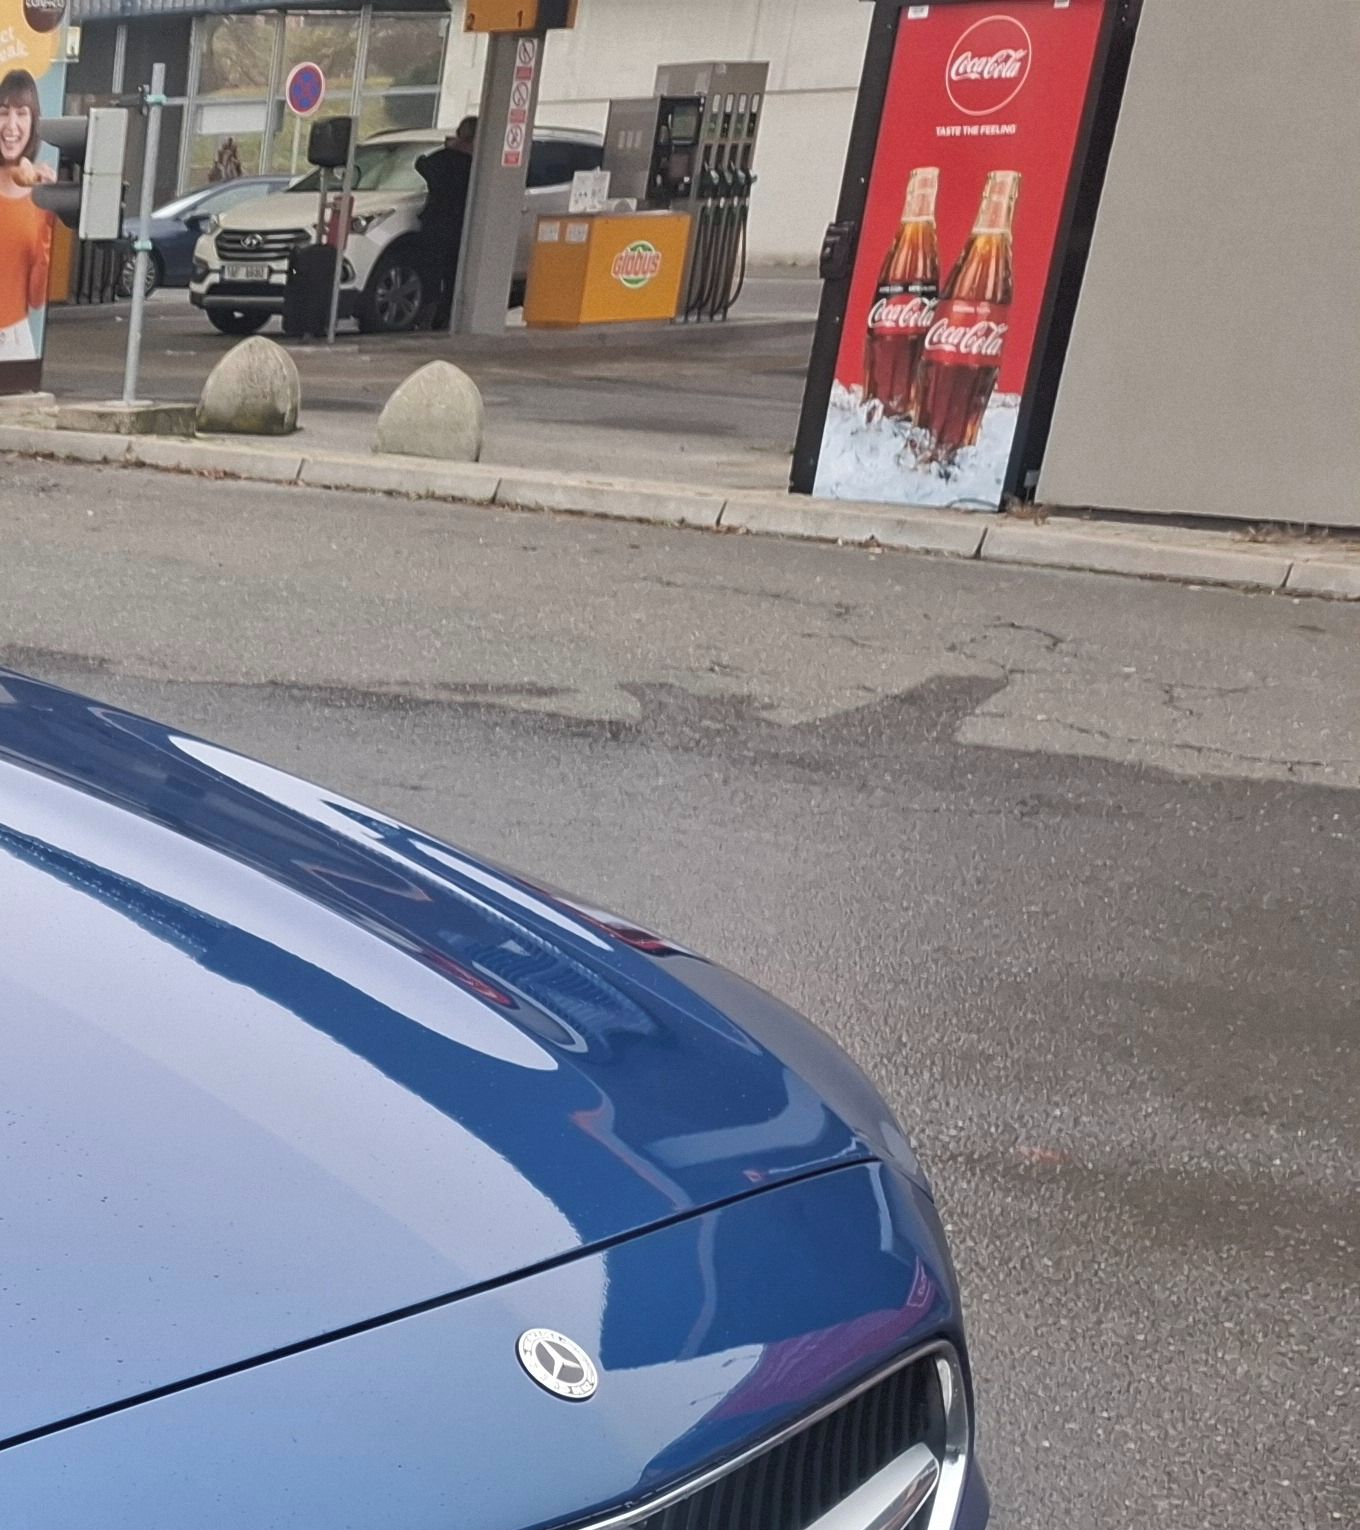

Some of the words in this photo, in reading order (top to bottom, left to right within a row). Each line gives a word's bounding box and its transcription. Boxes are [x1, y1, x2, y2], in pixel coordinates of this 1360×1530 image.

[466, 12, 476, 31] 2
[516, 10, 524, 28] 1
[936, 126, 962, 137] TASTE
[963, 125, 979, 136] THE
[980, 123, 1017, 135] FEELING
